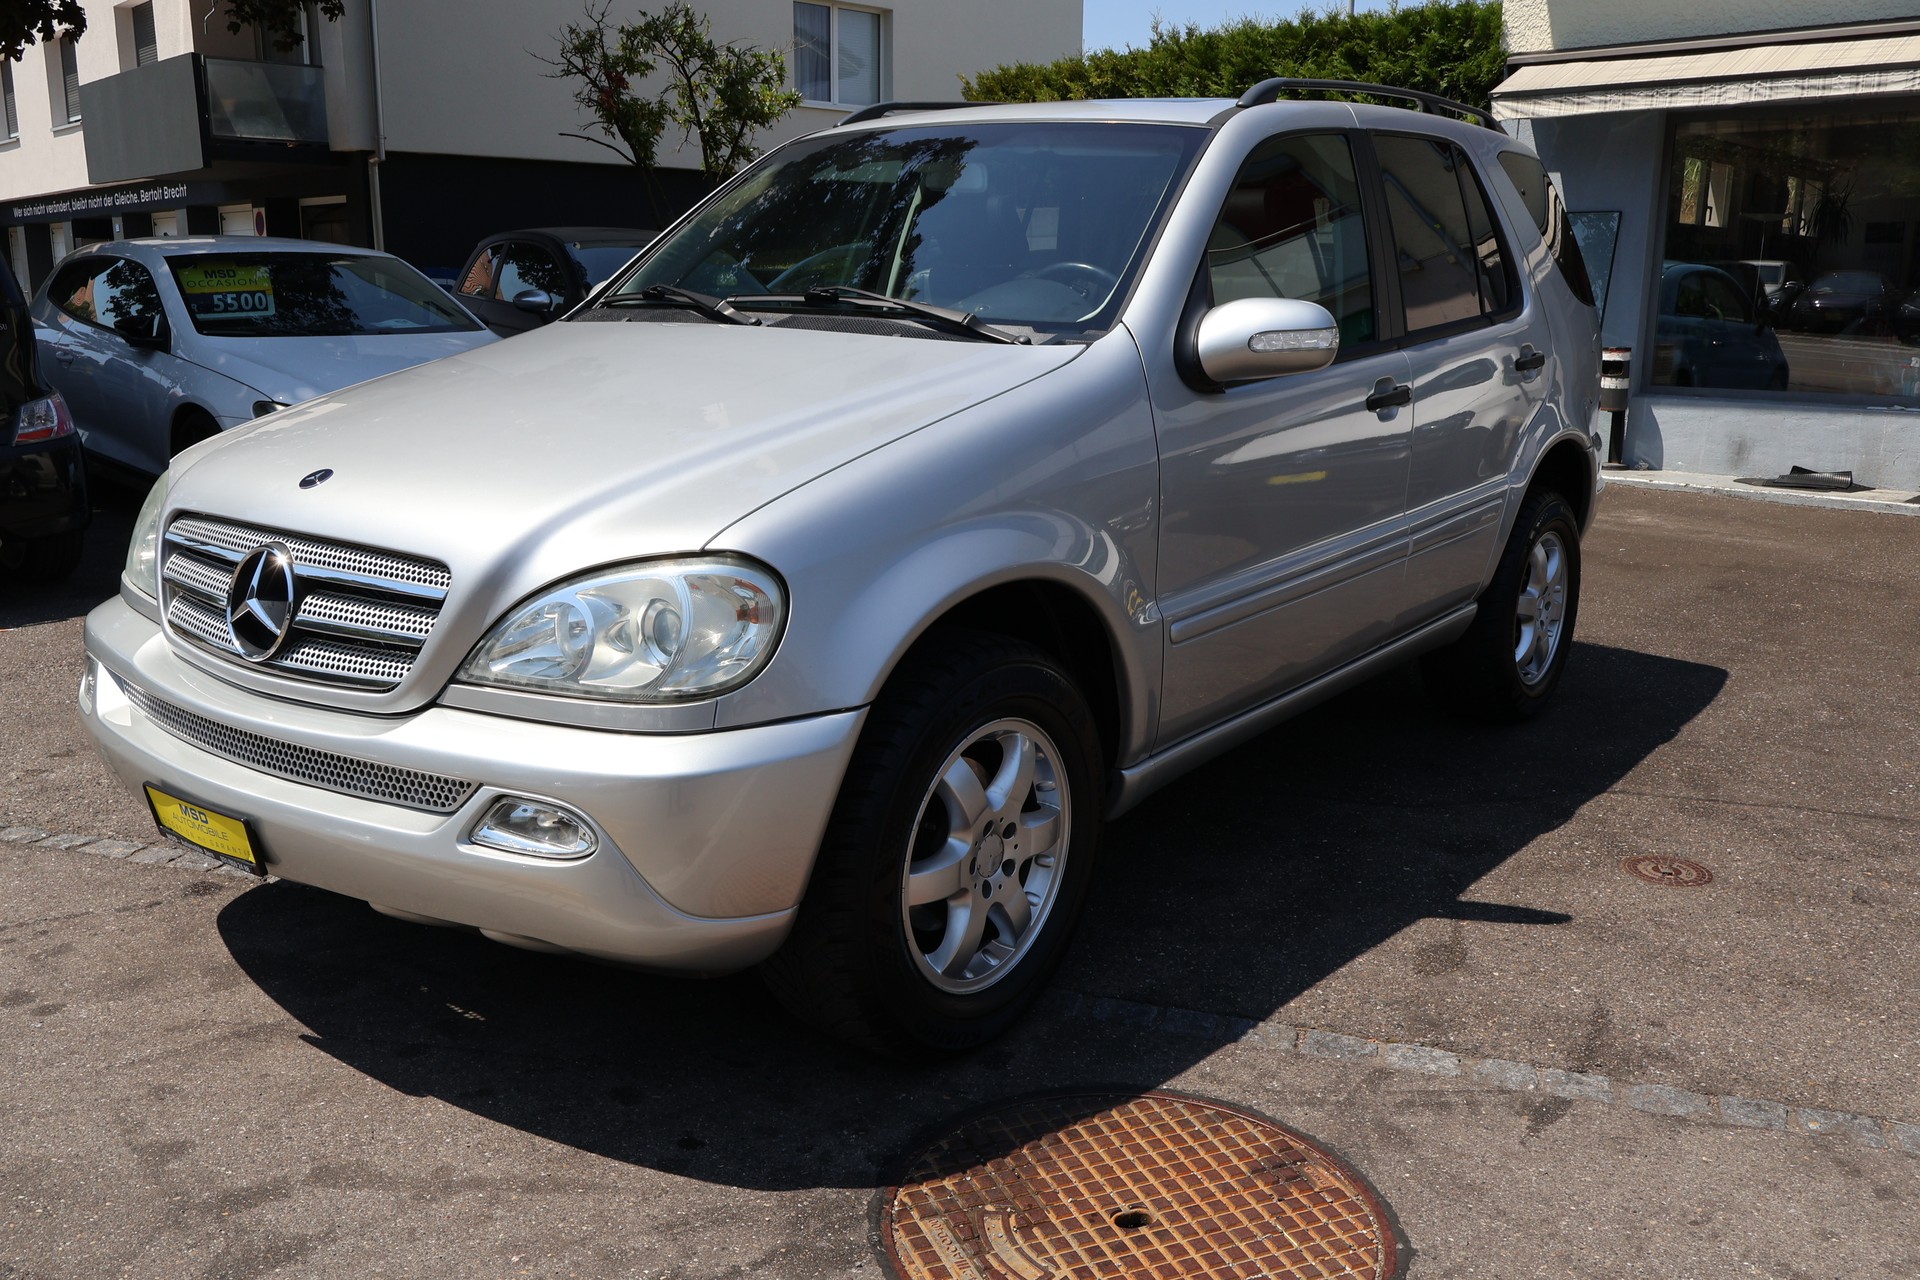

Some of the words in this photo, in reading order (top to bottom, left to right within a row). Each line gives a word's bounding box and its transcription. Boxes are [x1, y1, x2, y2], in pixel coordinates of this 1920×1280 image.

[13, 207, 23, 218] Wer
[23, 205, 34, 217] sich
[33, 203, 46, 215] nicht
[71, 197, 88, 211] bleibt
[88, 195, 103, 208] nicht
[103, 194, 114, 207] der
[114, 190, 140, 206] Gleiche.
[140, 186, 163, 202] Bertolt
[163, 183, 187, 199] Brecht
[186, 278, 258, 288] OCCASION
[203, 268, 237, 279] MSD
[212, 292, 267, 312] 5500
[179, 804, 208, 824] MSD
[172, 813, 229, 841] AUTOMOBILE
